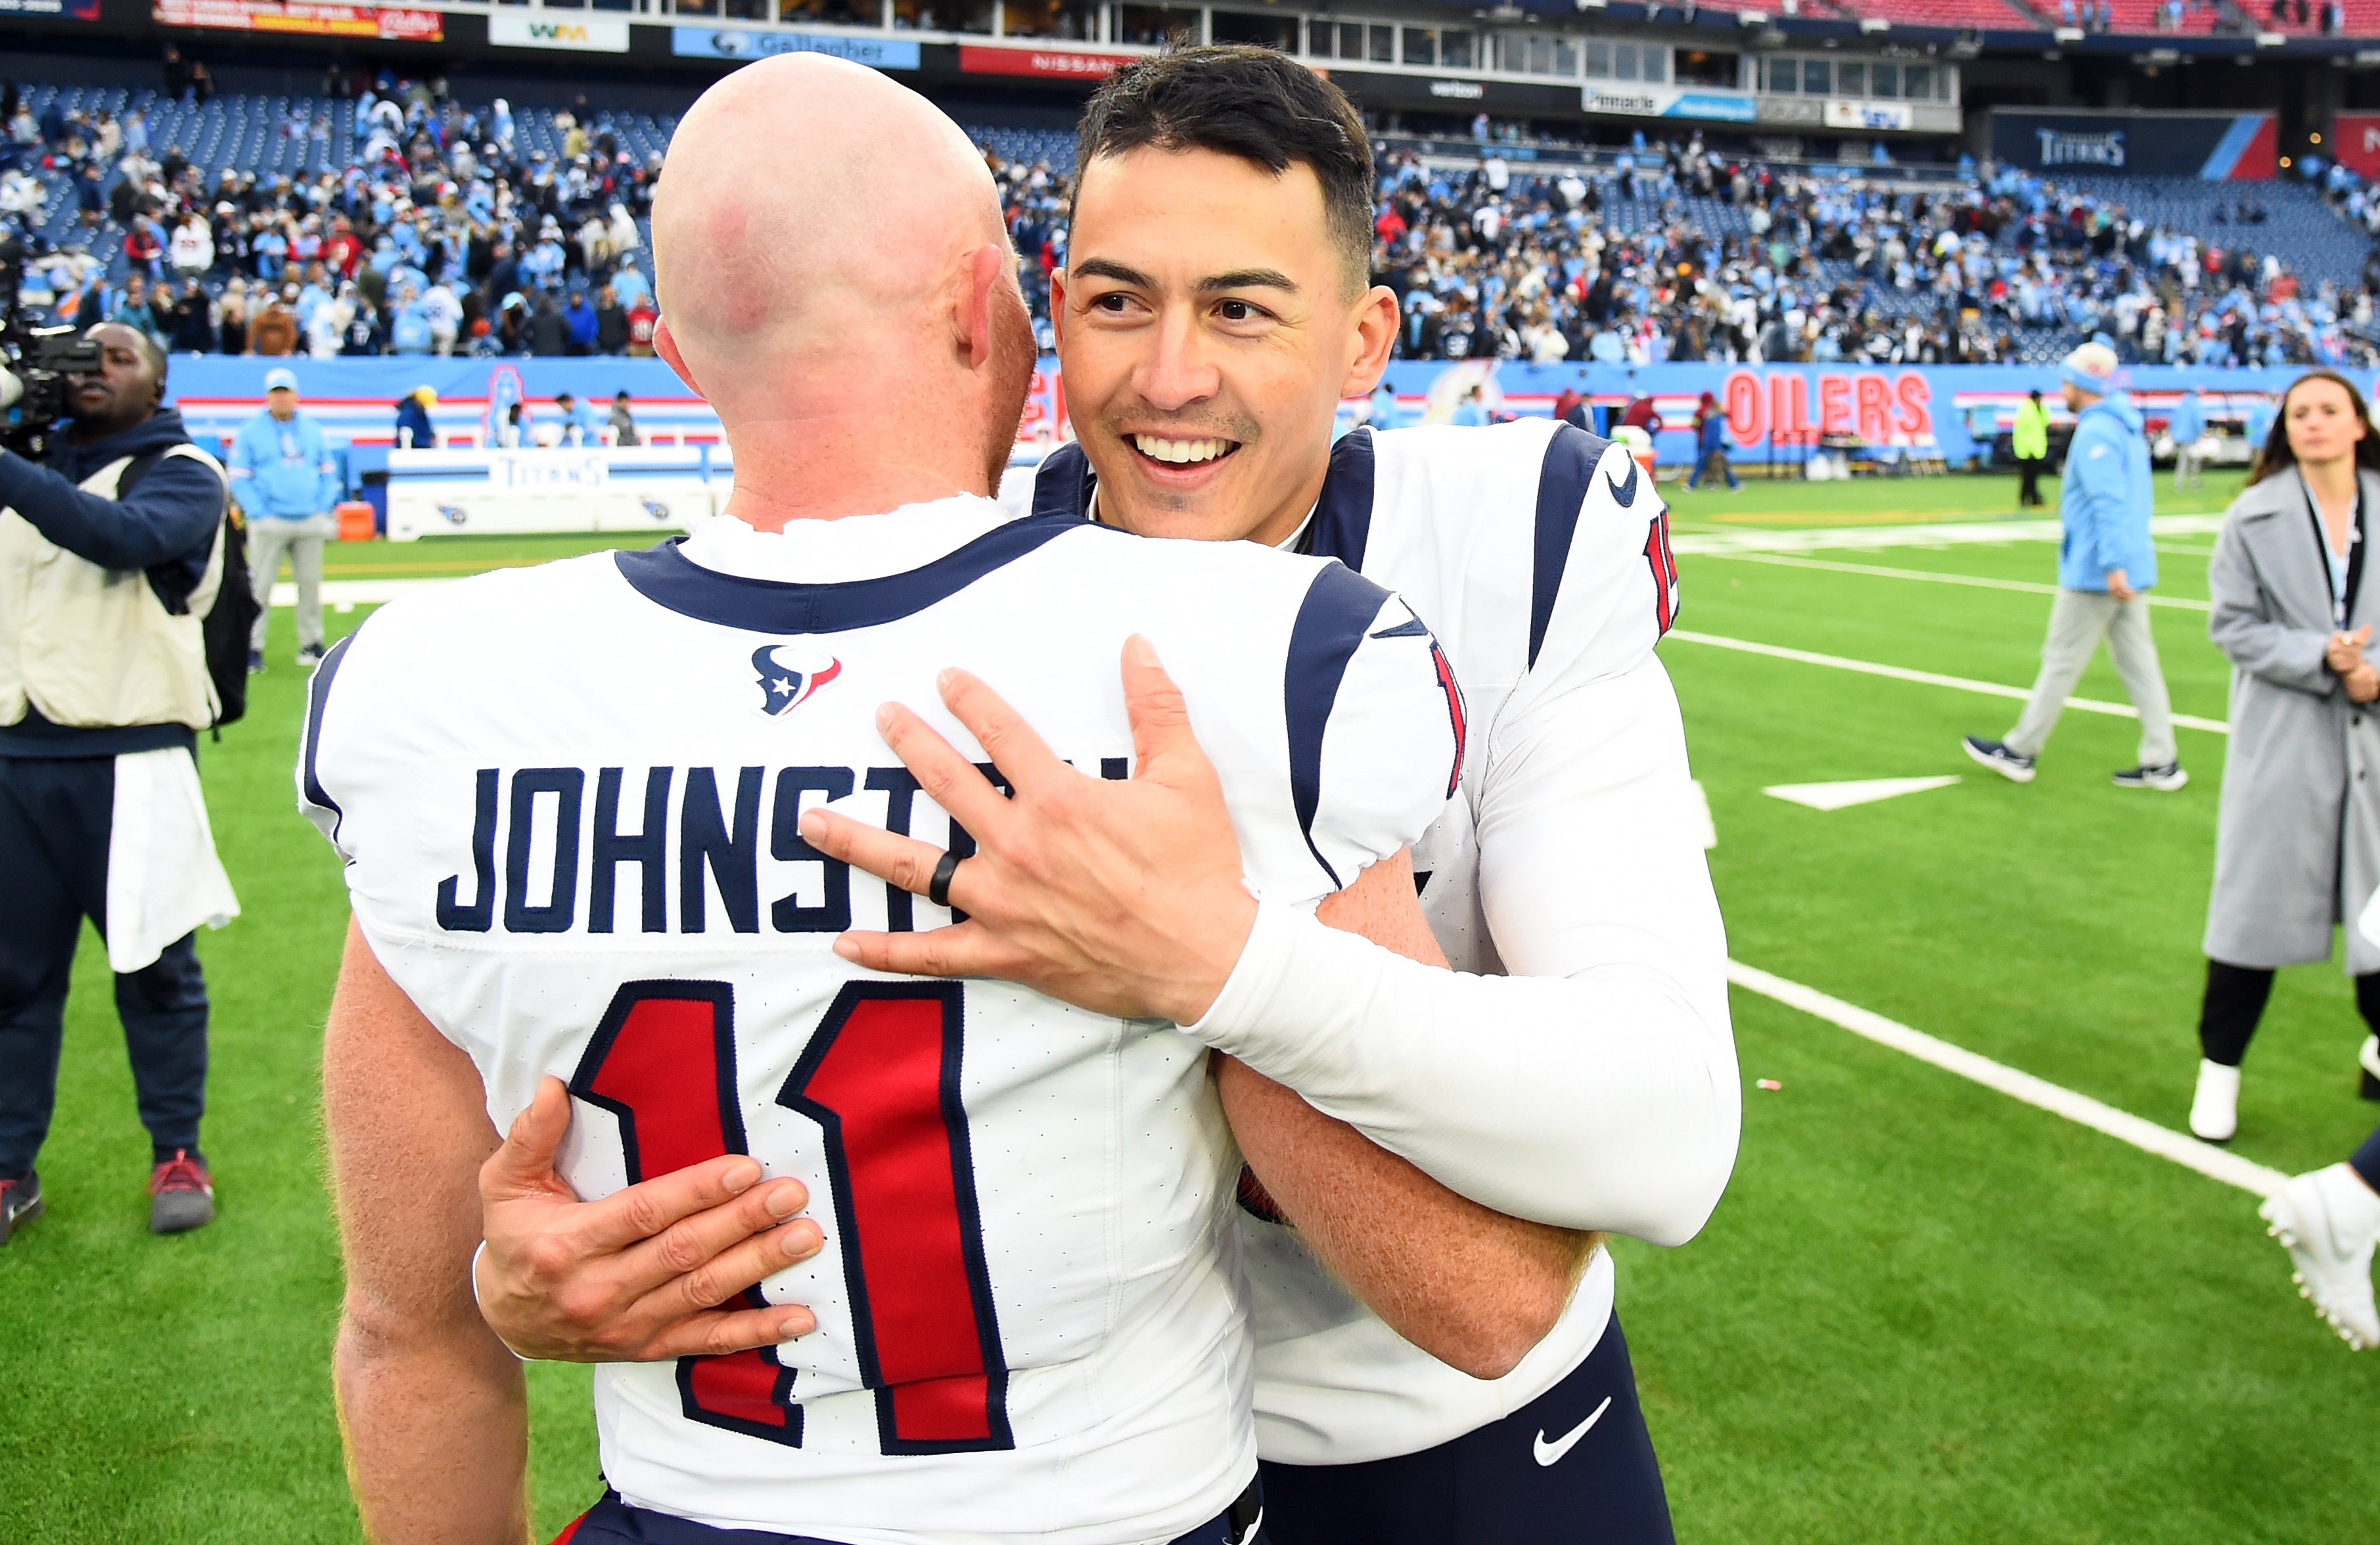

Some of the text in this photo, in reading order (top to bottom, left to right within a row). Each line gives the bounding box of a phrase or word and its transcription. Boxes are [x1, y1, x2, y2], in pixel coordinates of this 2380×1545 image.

[529, 24, 587, 42] WM
[1030, 54, 1115, 74] NISSAN
[1724, 370, 1932, 447] OILERS
[436, 757, 1129, 934] JOHNST
[568, 979, 1016, 1456] 11
